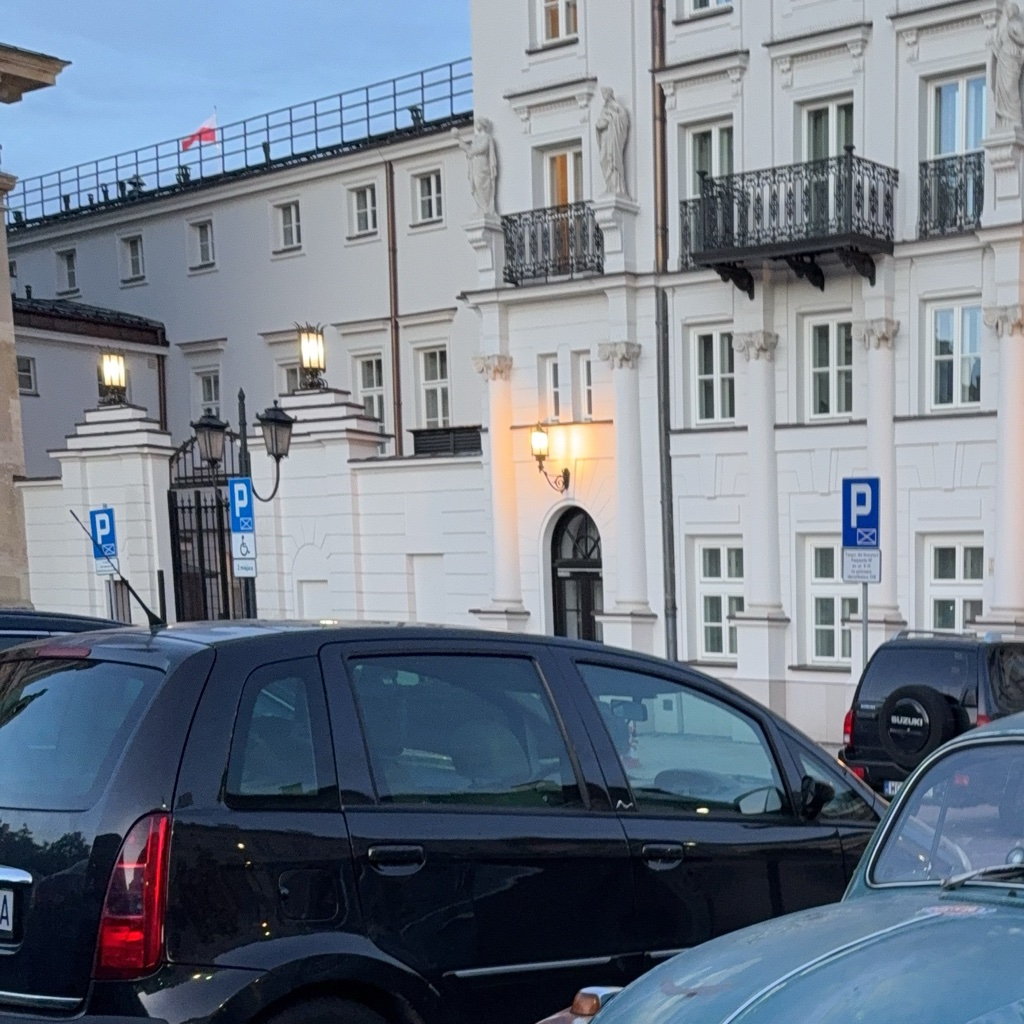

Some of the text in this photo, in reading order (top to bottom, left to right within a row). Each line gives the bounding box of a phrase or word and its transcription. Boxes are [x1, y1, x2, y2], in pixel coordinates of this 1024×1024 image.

[233, 483, 248, 517] P
[850, 483, 872, 528] P
[95, 513, 110, 544] P
[890, 715, 923, 727] SUZUKI
